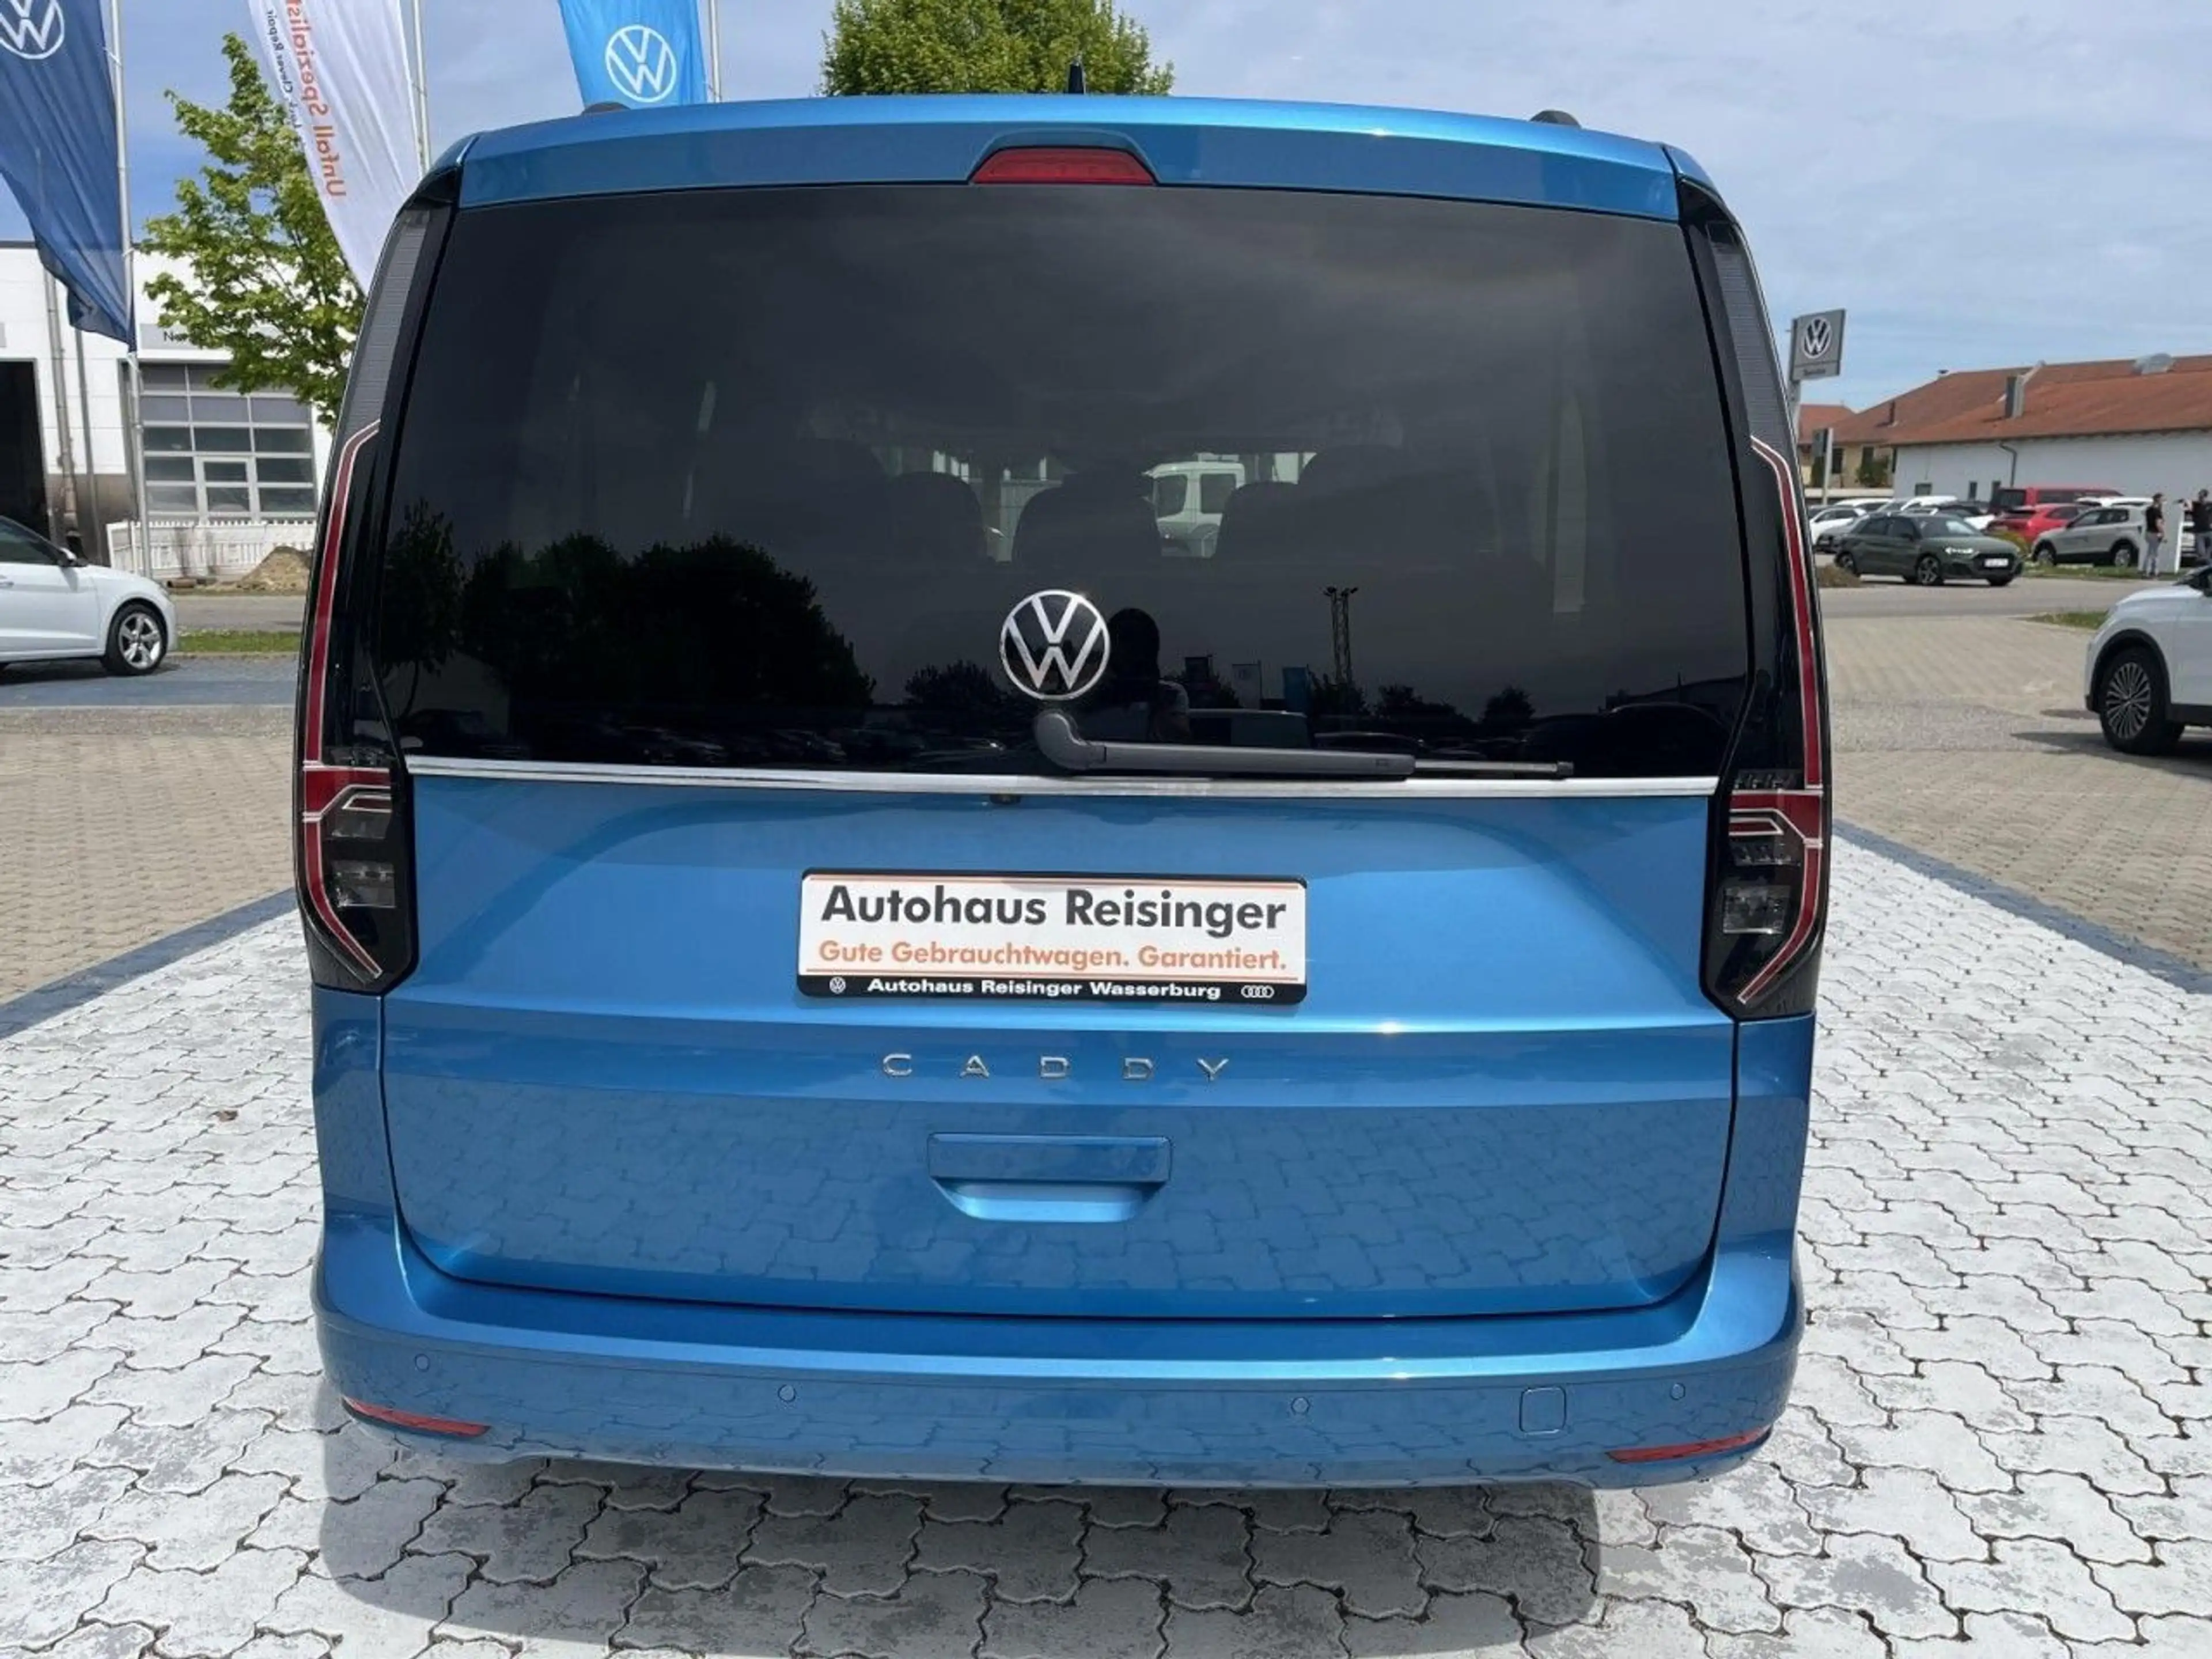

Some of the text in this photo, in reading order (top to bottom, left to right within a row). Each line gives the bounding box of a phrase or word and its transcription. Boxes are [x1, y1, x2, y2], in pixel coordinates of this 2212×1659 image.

[821, 885, 1286, 938] Autohaus Reisinger
[819, 940, 1286, 971] Gute Gebrauchtwagen. Garantiert.
[867, 979, 1221, 999] Autohaus Reisinger Wasserburg
[882, 1053, 1229, 1080] CADDY
